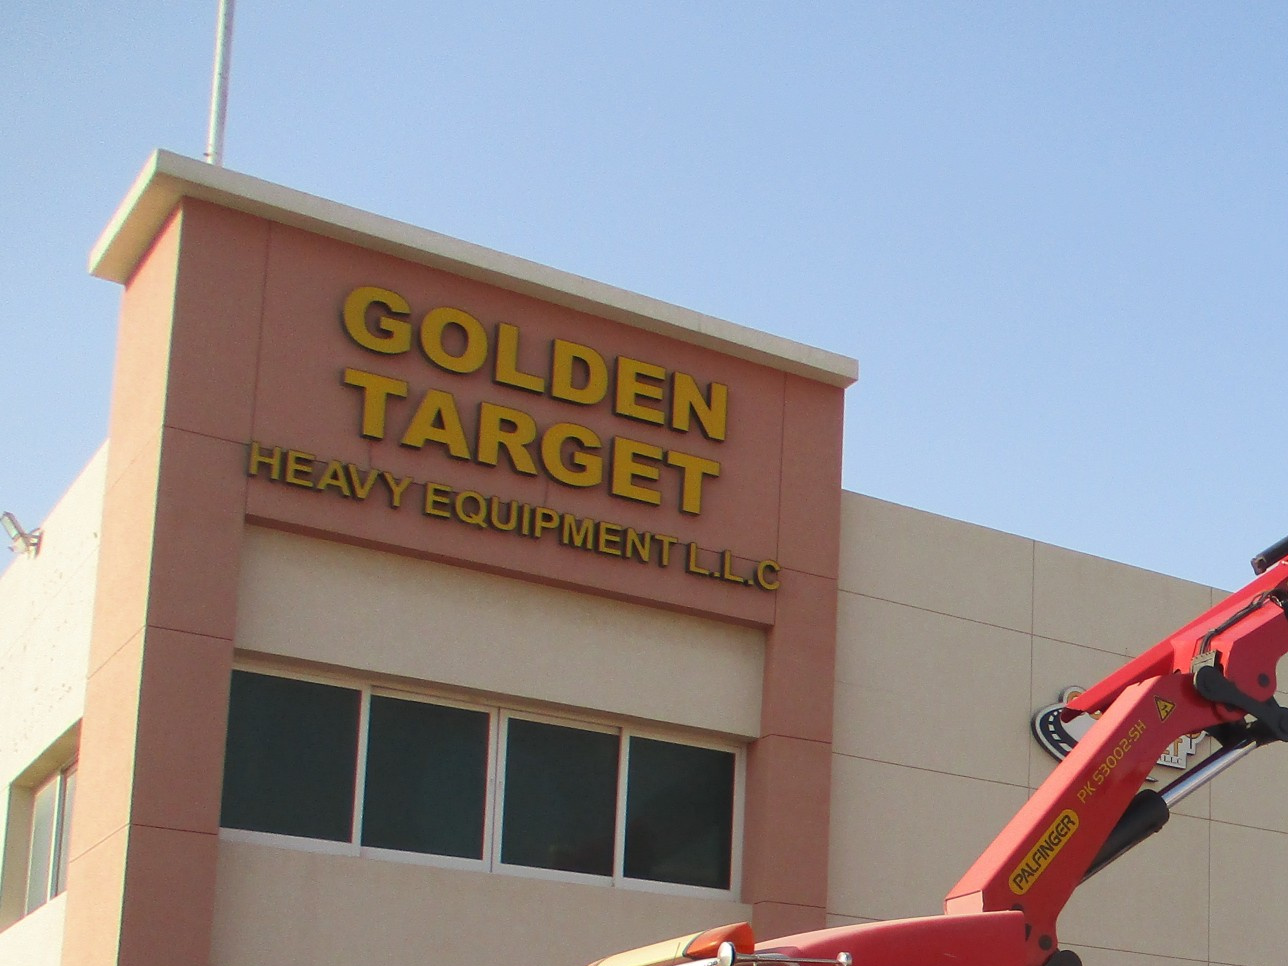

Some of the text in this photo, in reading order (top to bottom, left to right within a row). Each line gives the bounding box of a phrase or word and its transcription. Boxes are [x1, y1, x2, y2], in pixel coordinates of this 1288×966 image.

[341, 285, 728, 442] GOLDEN
[247, 440, 412, 508] HEAVY
[424, 481, 678, 567] EQUIPMENT
[342, 367, 722, 516] TARGET
[1012, 814, 1076, 891] PALFINGER
[1076, 781, 1096, 804] PK
